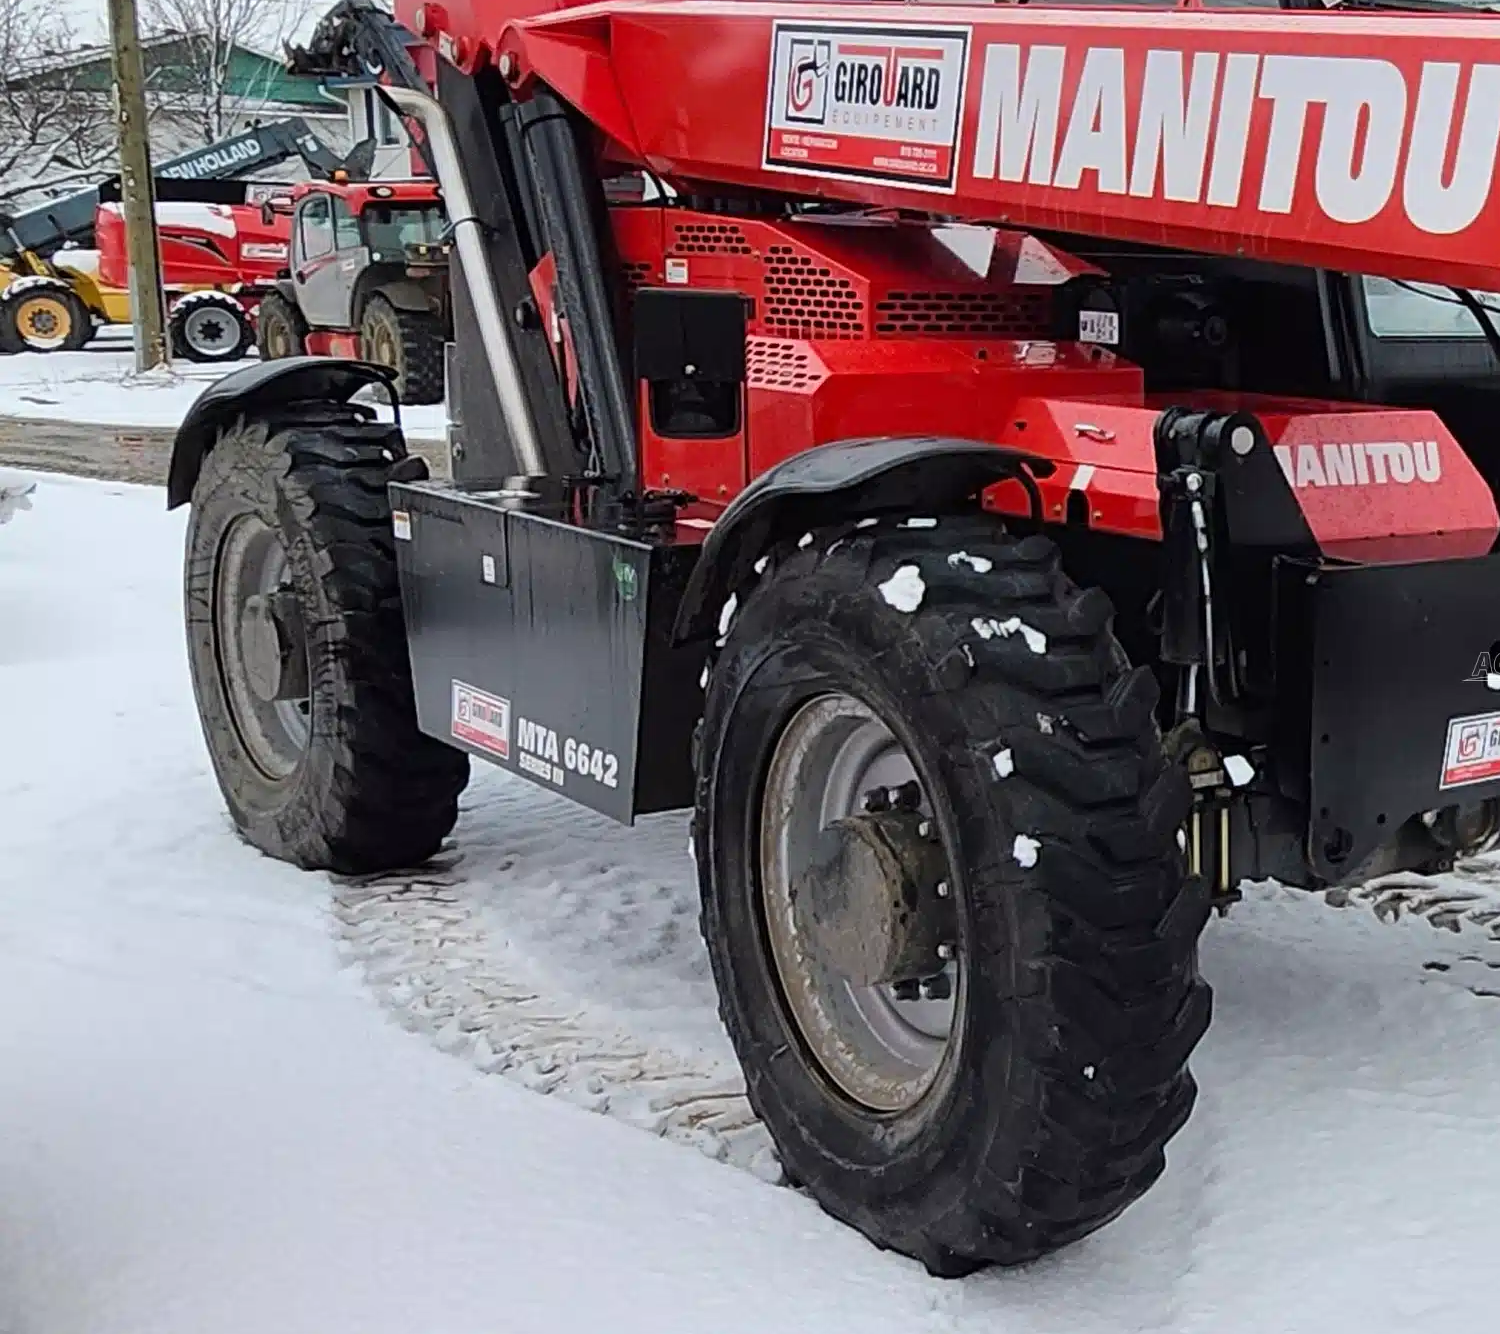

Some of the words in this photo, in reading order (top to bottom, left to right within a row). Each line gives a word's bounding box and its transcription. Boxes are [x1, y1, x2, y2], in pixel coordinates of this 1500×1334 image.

[834, 46, 942, 110] GIROUARD
[194, 139, 261, 175] HOLLAND
[518, 717, 560, 763] MTA
[564, 738, 618, 788] 6642
